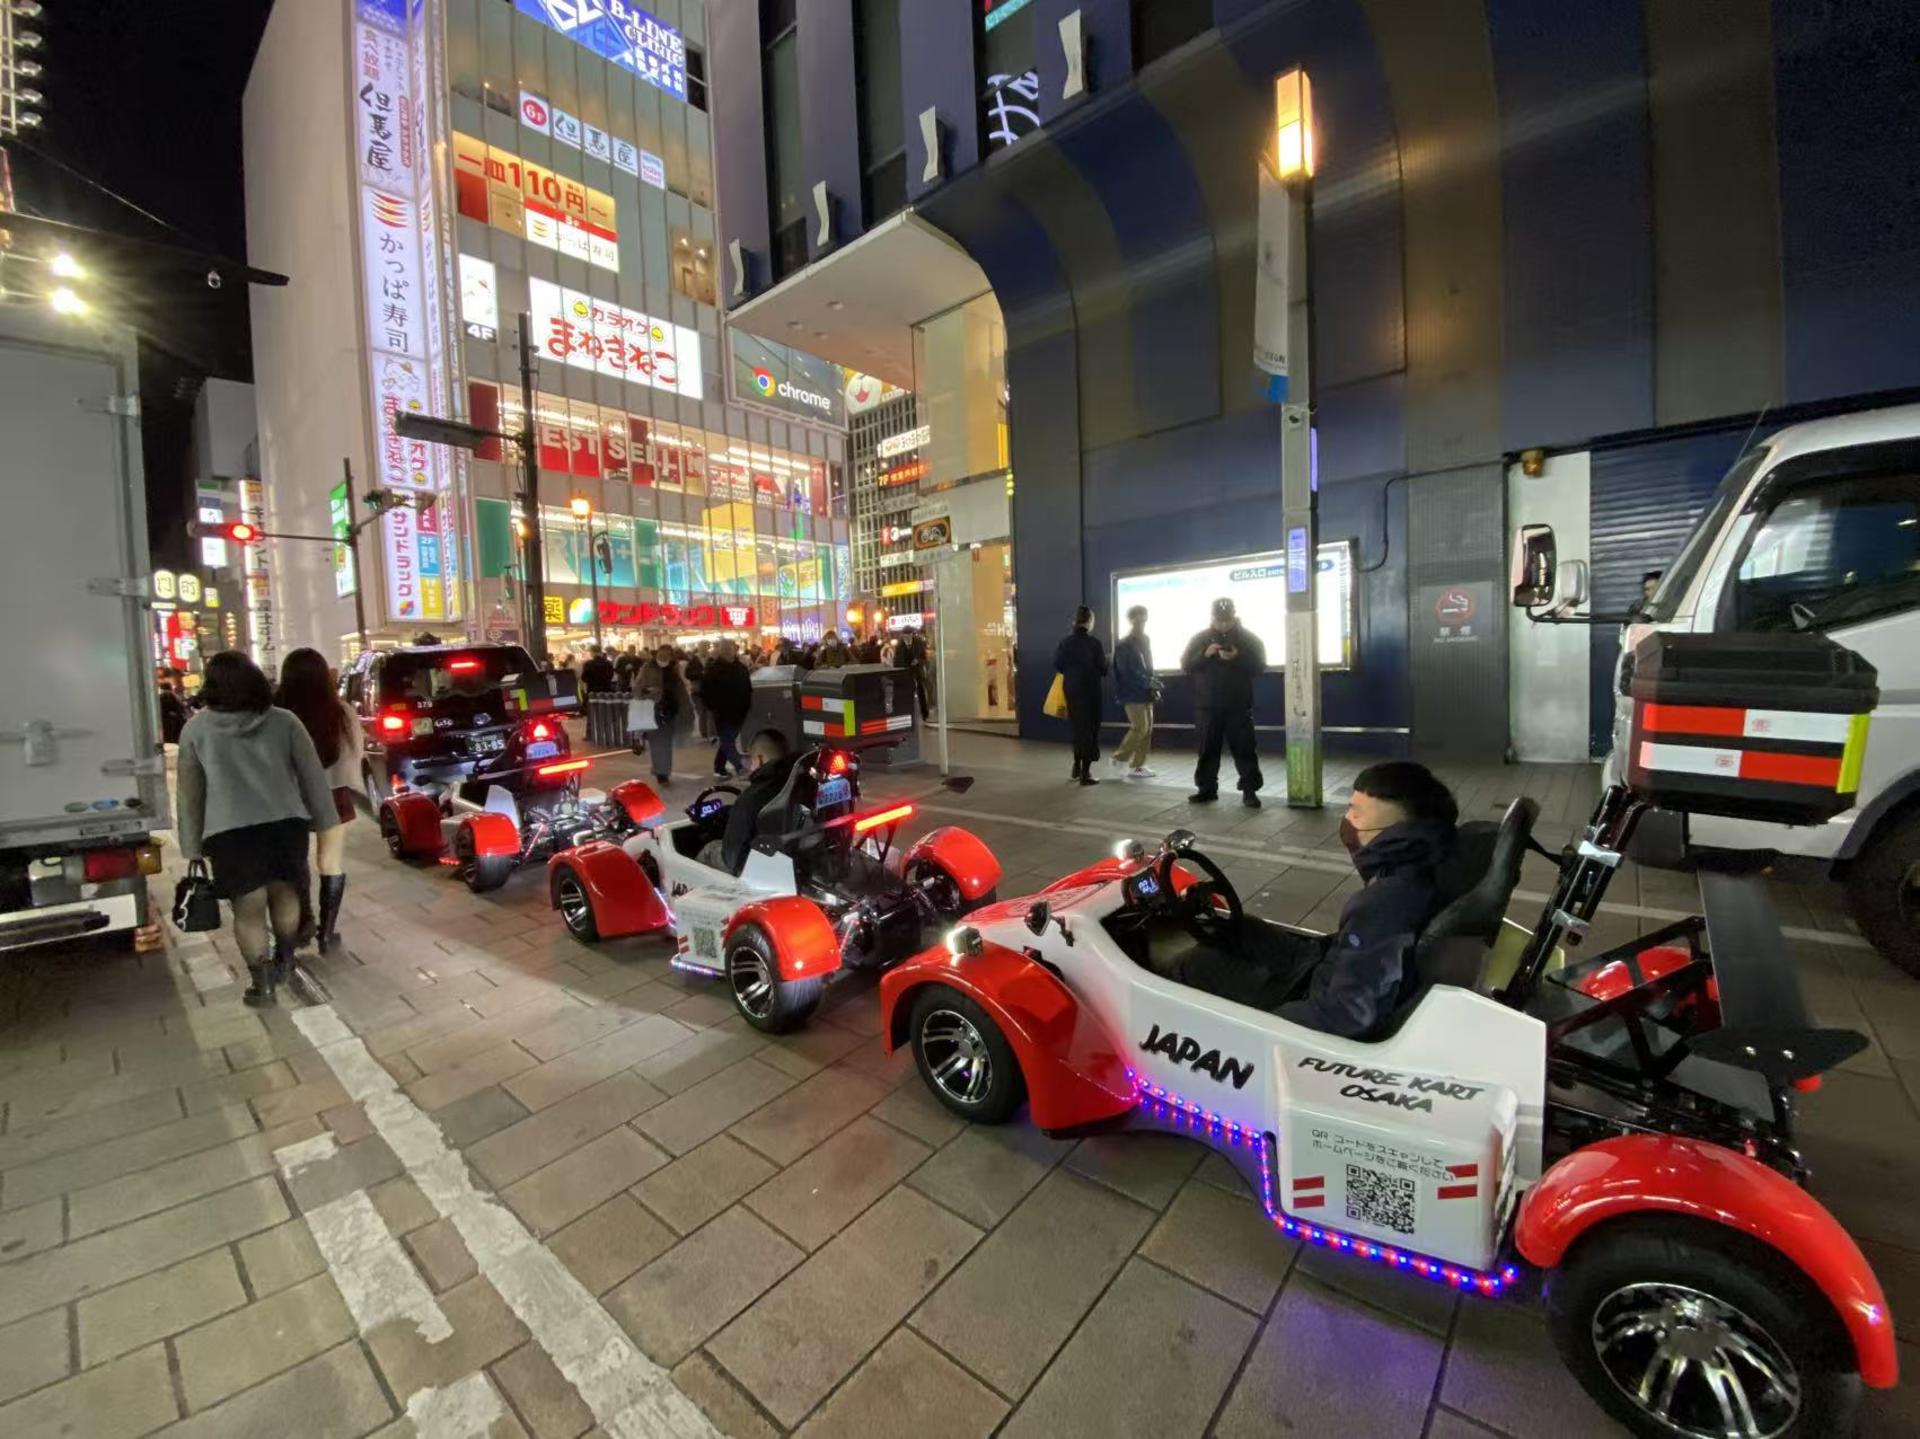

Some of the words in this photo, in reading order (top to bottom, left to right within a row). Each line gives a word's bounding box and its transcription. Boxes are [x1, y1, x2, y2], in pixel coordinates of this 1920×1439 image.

[610, 1, 682, 53] B-LINE
[625, 25, 683, 67] CLINIC
[525, 103, 544, 122] 6F
[379, 232, 409, 353] かっぱ寿司
[467, 323, 495, 341] 4F
[591, 306, 651, 335] カラオケ
[547, 316, 680, 385] まねきねこ
[778, 380, 831, 411] chrome
[1139, 1024, 1254, 1090] JAPAN
[1298, 1056, 1402, 1085] FUTURE
[1408, 1074, 1486, 1102] KART
[1339, 1083, 1433, 1114] OSAKA
[1311, 1129, 1328, 1141] QR
